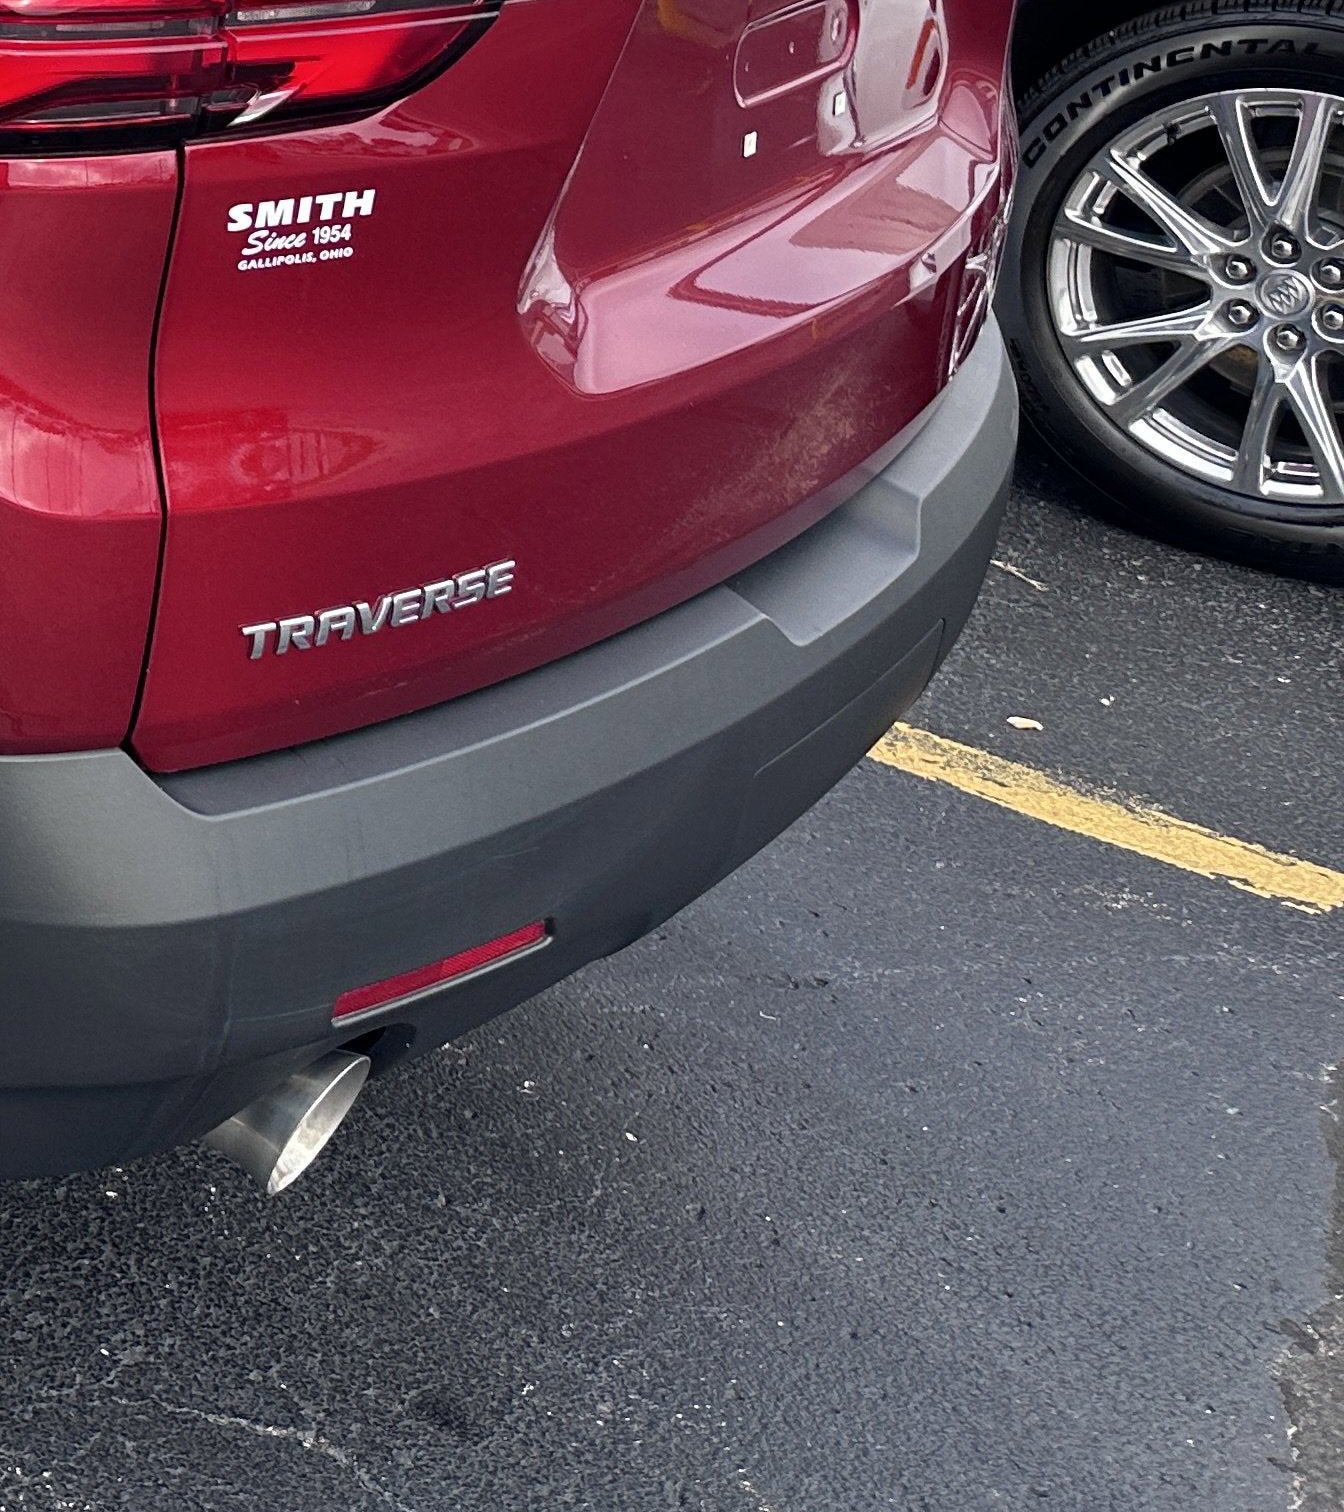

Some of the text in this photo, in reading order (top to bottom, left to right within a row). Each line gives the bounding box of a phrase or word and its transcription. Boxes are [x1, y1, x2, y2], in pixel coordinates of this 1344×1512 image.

[227, 189, 376, 232] SMITH
[237, 246, 354, 271] GALLIPOLIS, OHIO
[241, 223, 352, 256] Since 1954
[239, 559, 517, 661] TRAVERSE
